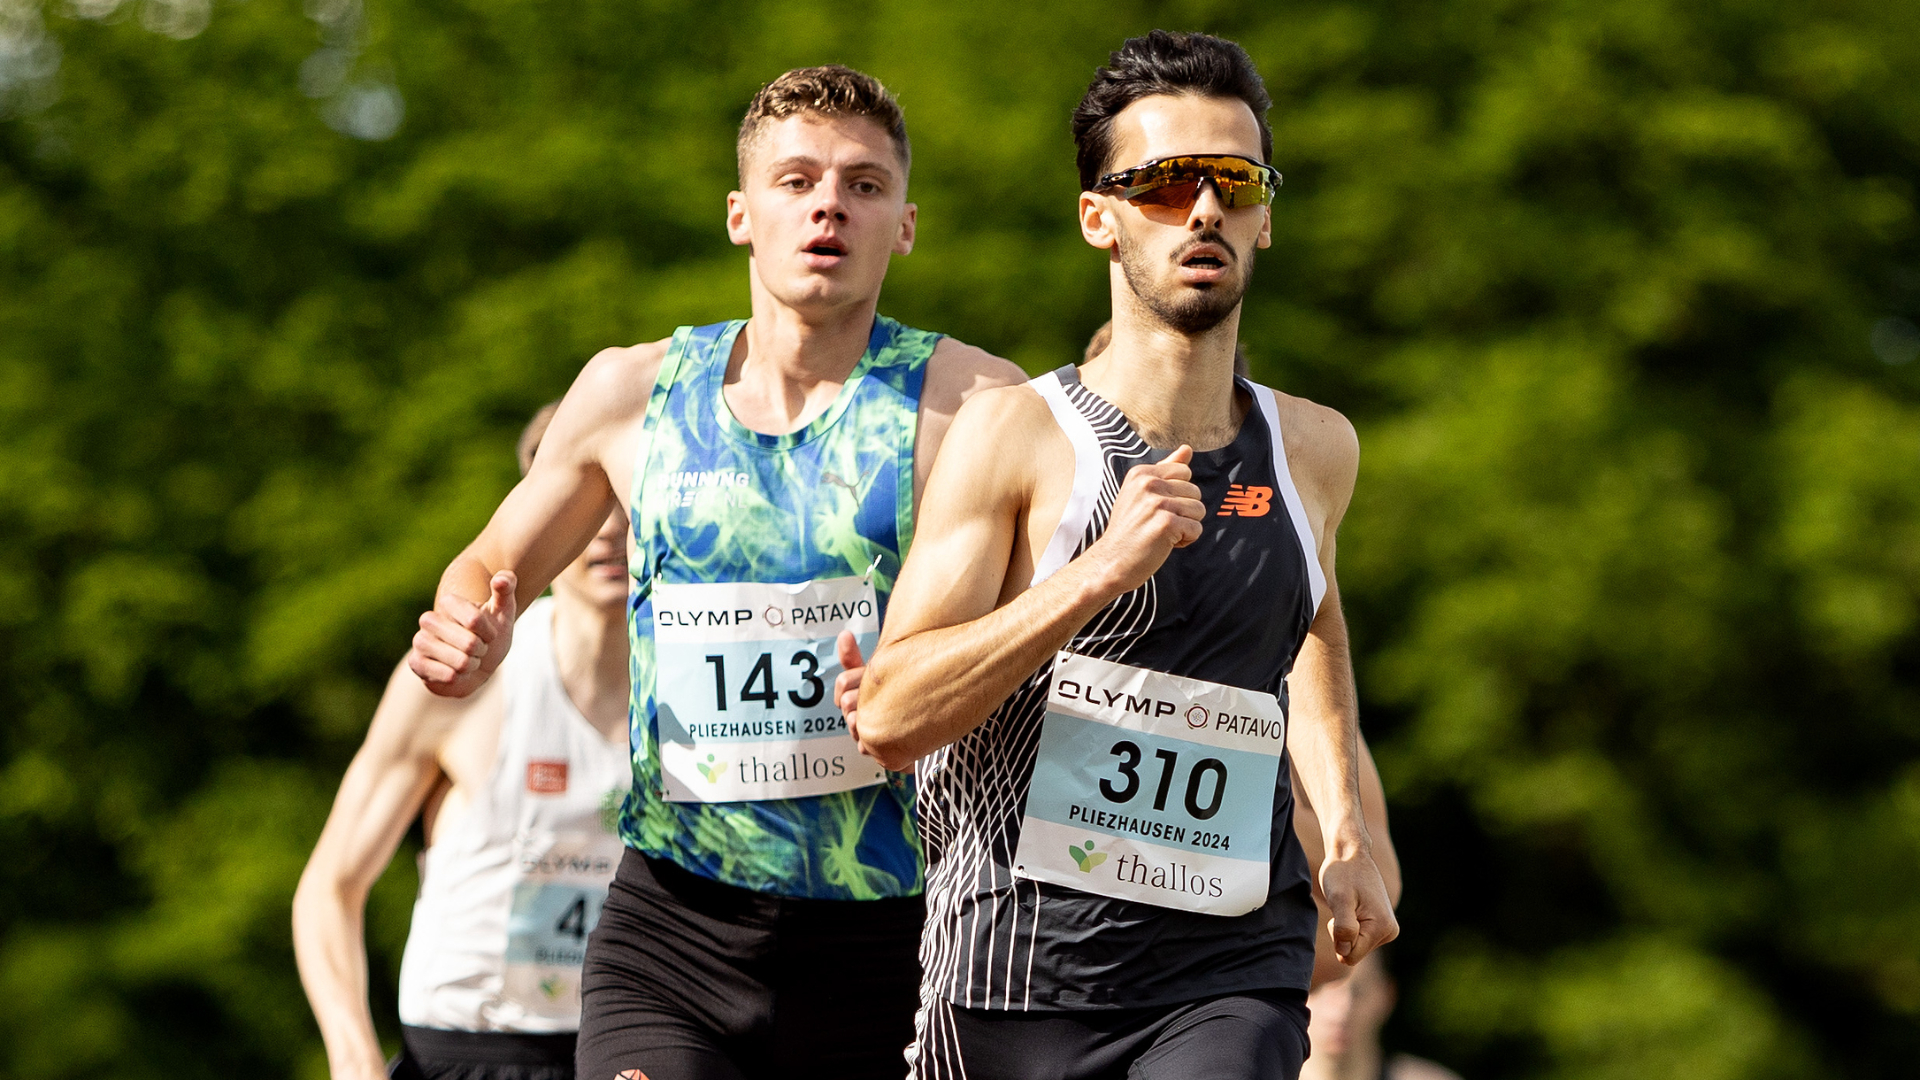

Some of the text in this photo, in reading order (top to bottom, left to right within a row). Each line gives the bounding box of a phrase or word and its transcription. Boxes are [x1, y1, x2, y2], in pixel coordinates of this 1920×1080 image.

[656, 471, 750, 489] RUNNING
[659, 600, 872, 626] OLYMP PATAVO
[705, 650, 825, 712] 143
[690, 716, 847, 738] PLIEZHAUSEN 2024
[1058, 680, 1281, 740] OLYMP PATAVO
[738, 753, 846, 784] thallos
[1099, 740, 1228, 821] 310
[1069, 804, 1230, 851] PLIEZHAUSEN 2024
[1116, 854, 1223, 898] thallos
[555, 892, 598, 942] 4
